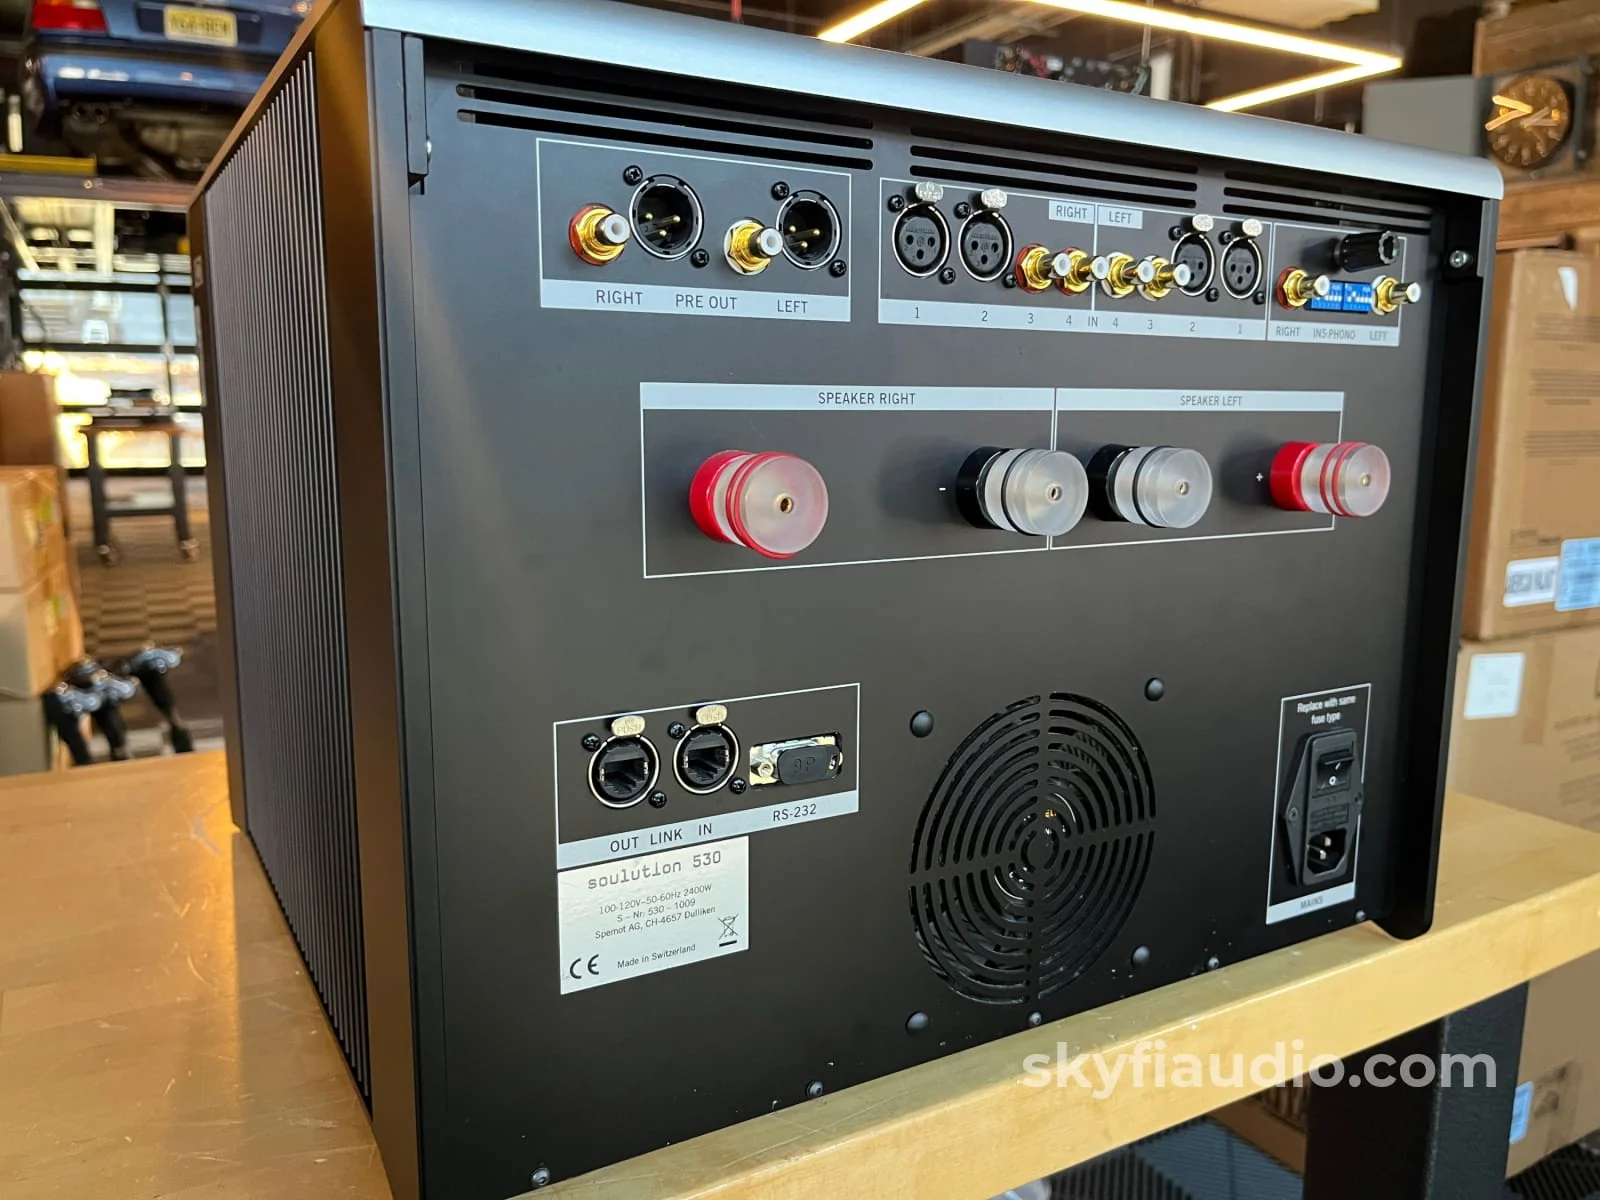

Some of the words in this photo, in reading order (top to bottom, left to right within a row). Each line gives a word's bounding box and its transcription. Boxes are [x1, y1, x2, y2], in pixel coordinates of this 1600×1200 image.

[1056, 206, 1088, 219] RIGHT
[1108, 211, 1133, 225] LEFT
[596, 289, 643, 305] RIGHT
[675, 293, 704, 308] PRE
[708, 296, 738, 310] OUT
[776, 299, 809, 313] LEFT
[914, 307, 920, 319] 1
[981, 310, 988, 322] 2
[1027, 313, 1034, 324] 3
[1065, 315, 1073, 326] 4
[1088, 316, 1098, 328] IN
[1112, 317, 1119, 328] 4
[1147, 320, 1153, 331] 3
[1189, 321, 1196, 332] 2
[1275, 326, 1300, 338] RIGHT
[1369, 331, 1387, 341] LEFT
[818, 392, 875, 405] SPEAKER
[879, 393, 916, 405] RIGHT
[1180, 395, 1220, 407] SPEAKER
[1222, 396, 1243, 407] LEFT
[773, 803, 817, 822] RS-232
[610, 837, 640, 853] OUT
[650, 828, 683, 845] LINK
[698, 823, 713, 836] IN
[588, 862, 682, 890] soulution
[692, 850, 721, 868] 530
[683, 883, 713, 898] 2400W
[647, 904, 665, 916] 530
[675, 898, 696, 910] 1009
[645, 912, 682, 928] CH-4657
[617, 958, 640, 969] Made
[641, 955, 650, 964] in
[651, 944, 696, 961] Switzerland
